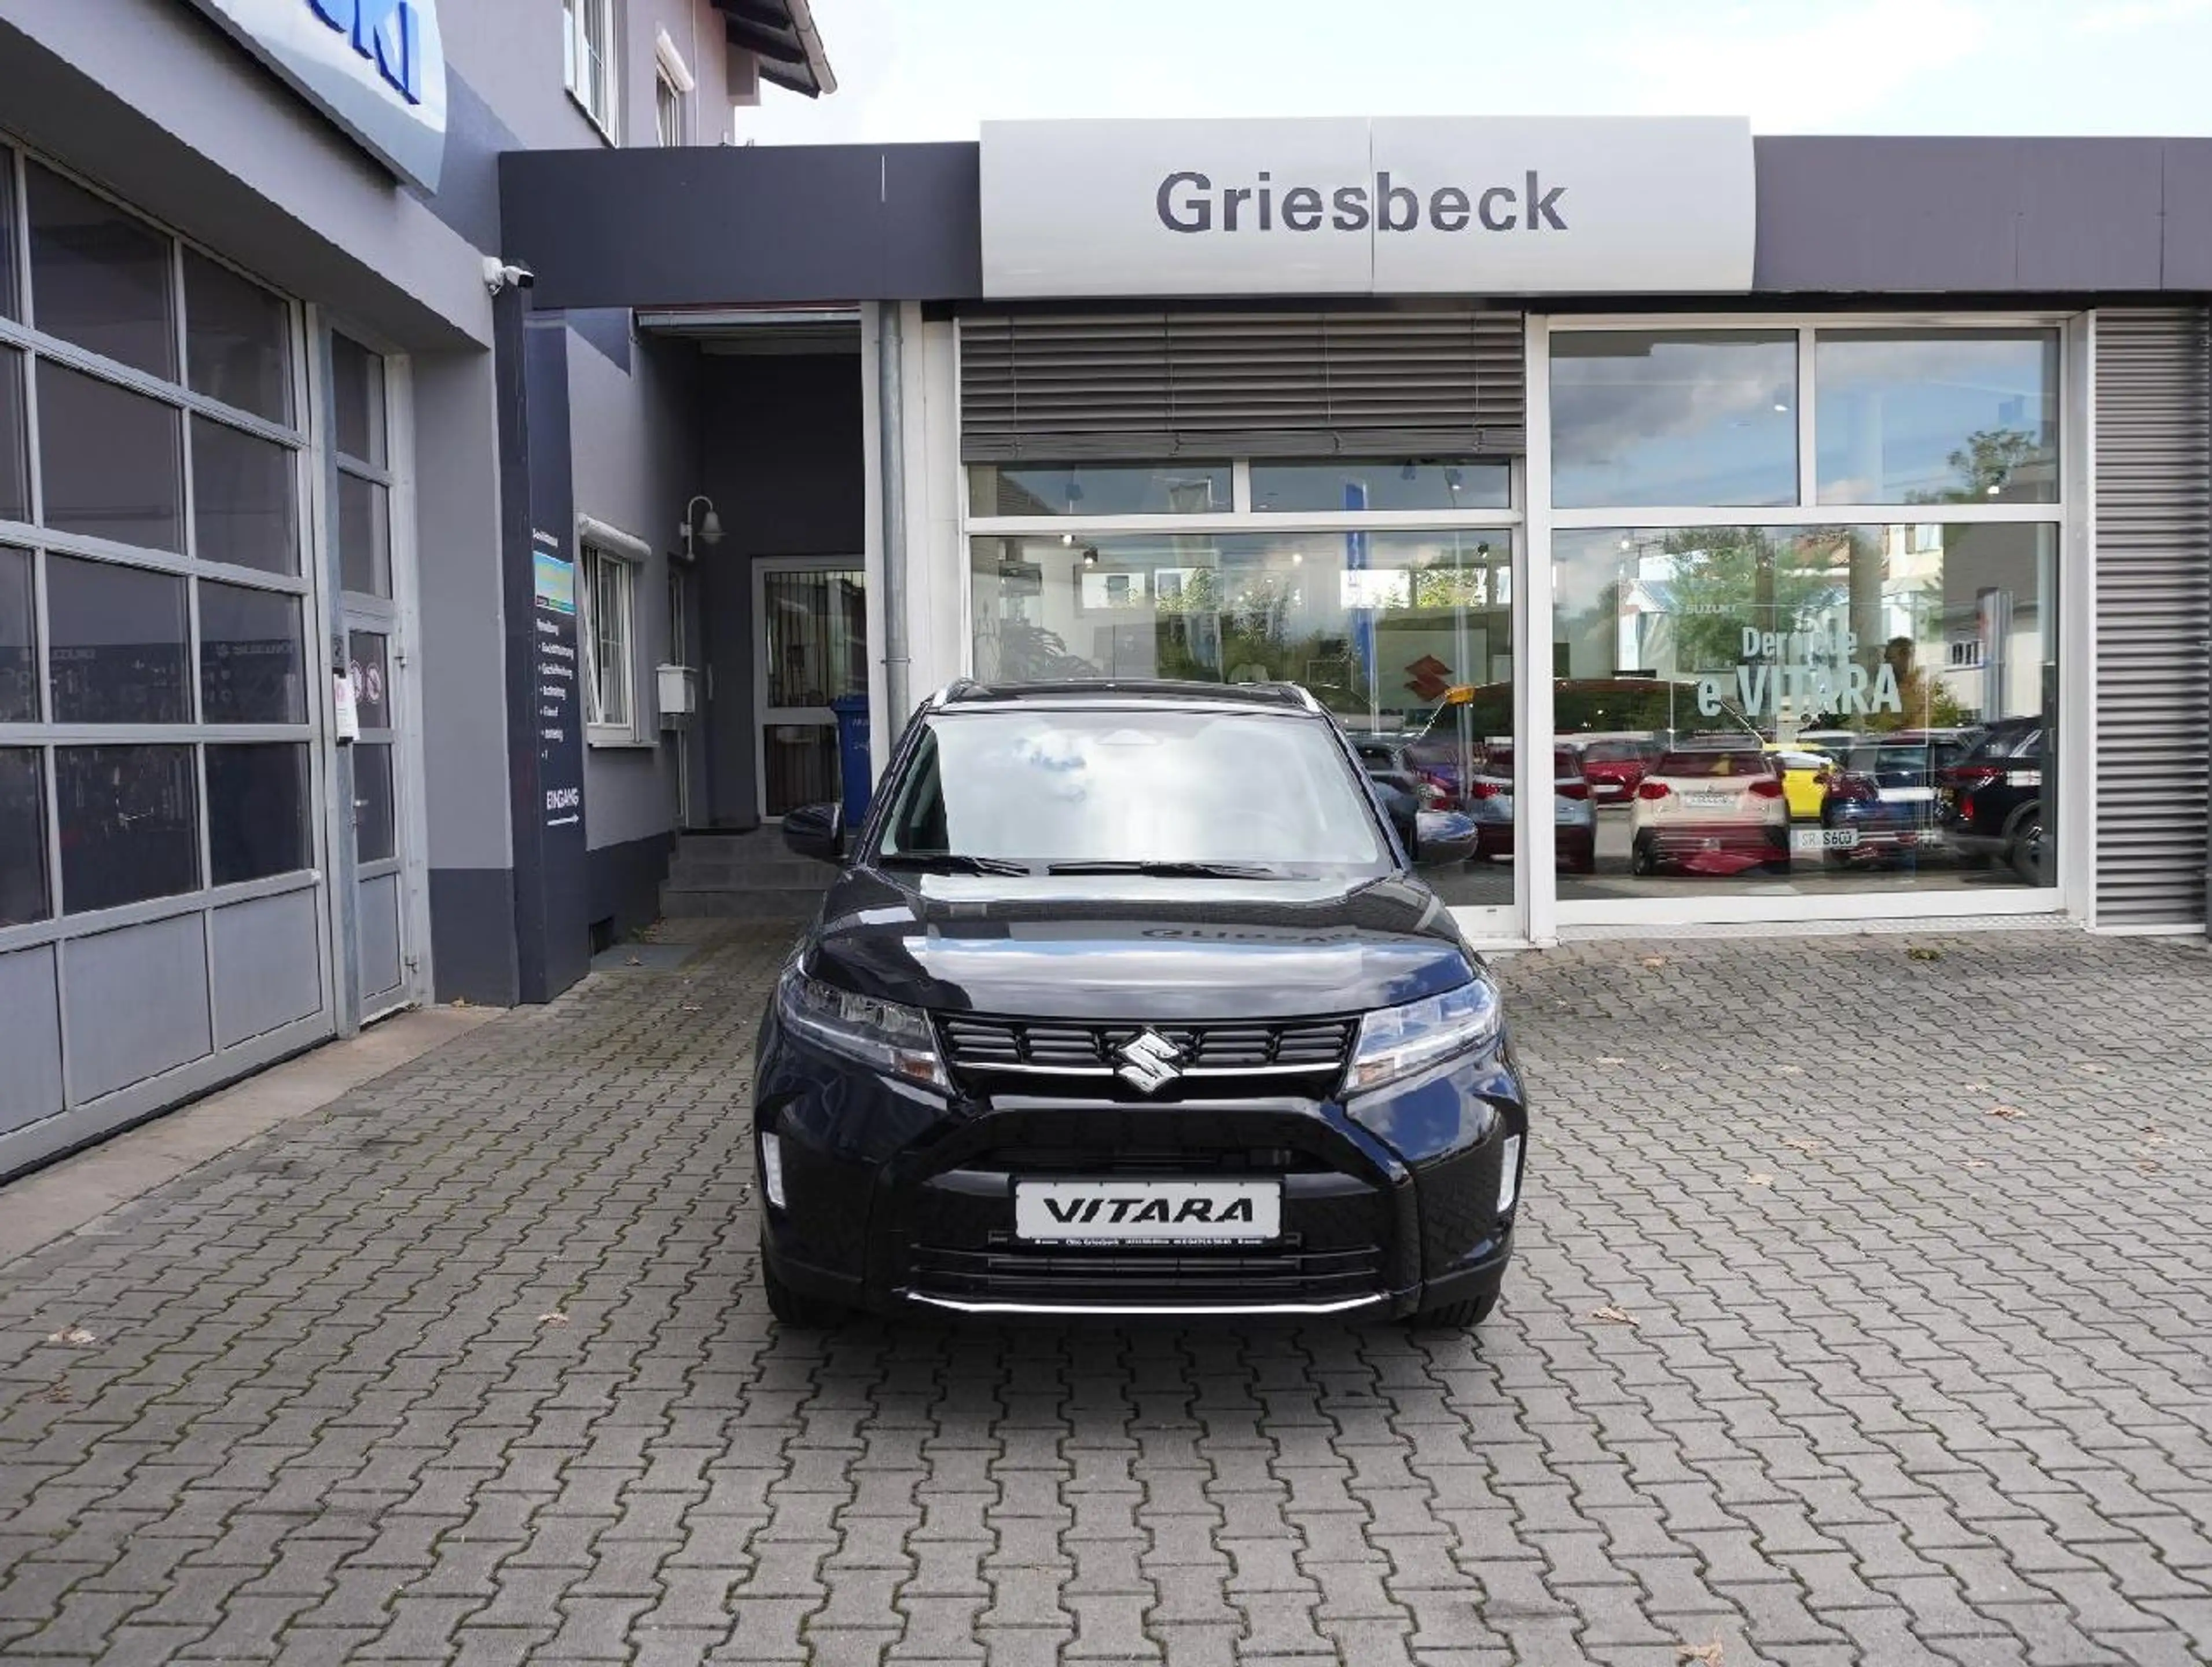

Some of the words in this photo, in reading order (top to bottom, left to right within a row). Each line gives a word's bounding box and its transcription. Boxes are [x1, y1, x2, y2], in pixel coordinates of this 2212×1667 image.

[1157, 170, 1568, 233] Griesbeck
[1743, 626, 1788, 657] Der
[1697, 678, 1722, 716] e
[1737, 663, 1902, 717] VITARA
[547, 788, 579, 810] EINGANG
[1043, 1198, 1252, 1223] VITARA
